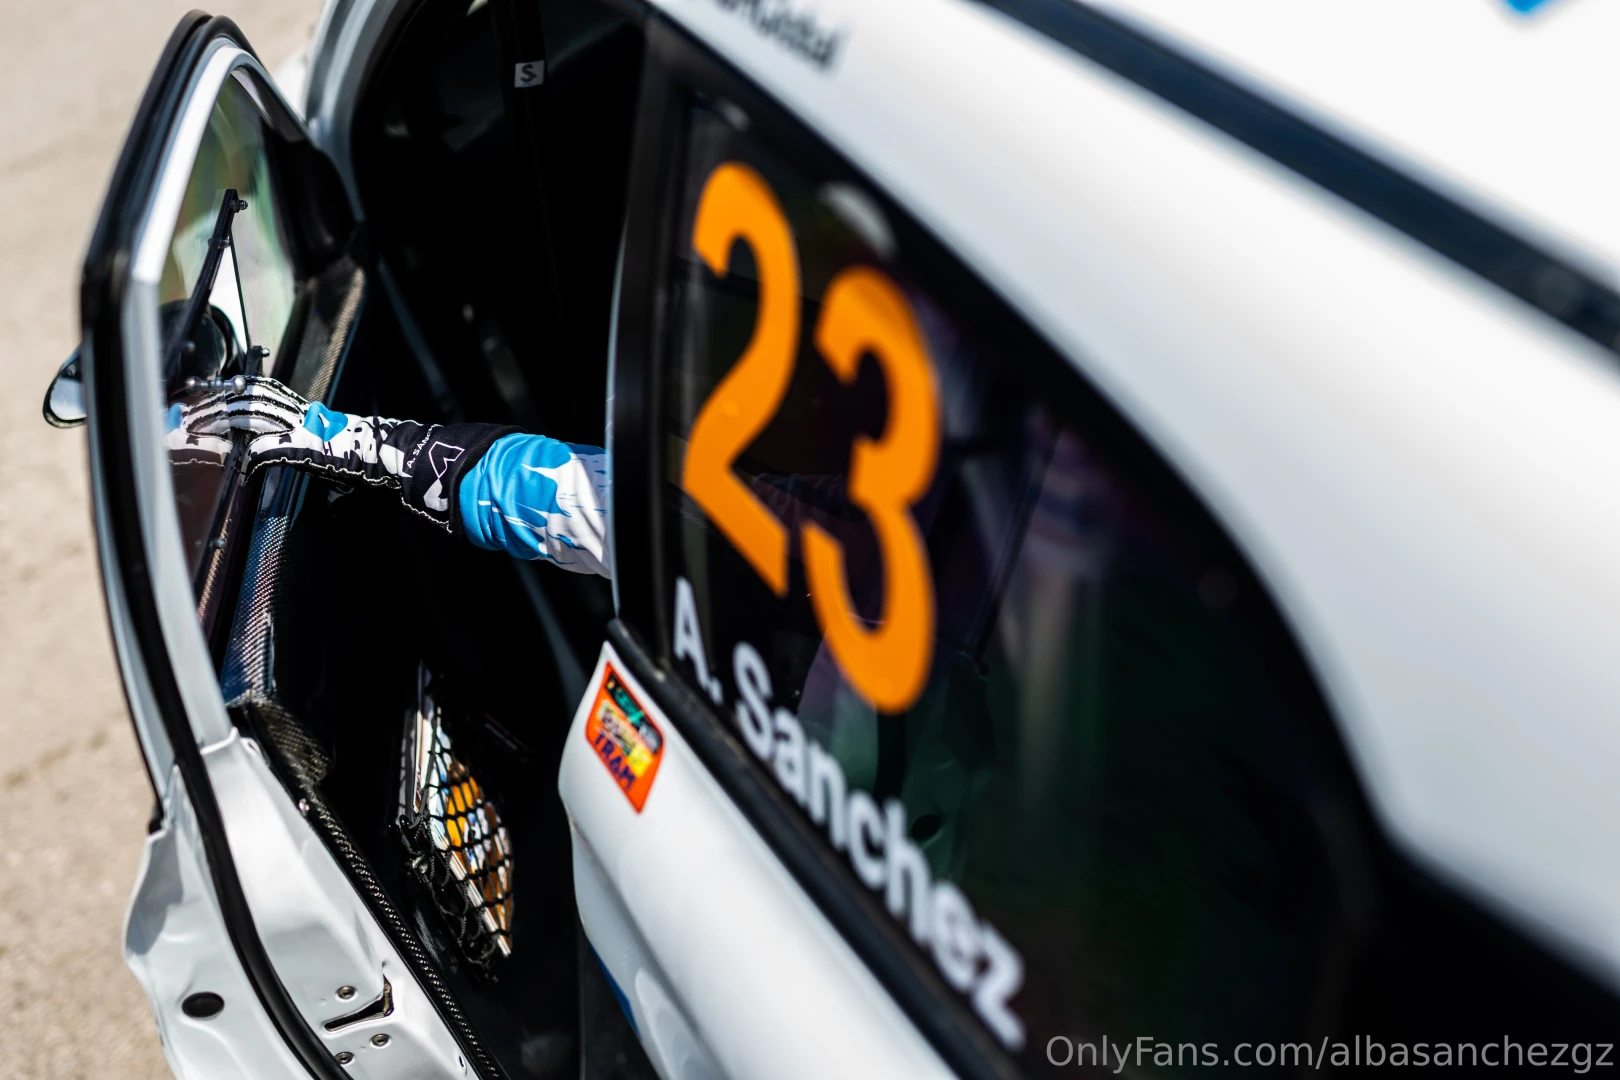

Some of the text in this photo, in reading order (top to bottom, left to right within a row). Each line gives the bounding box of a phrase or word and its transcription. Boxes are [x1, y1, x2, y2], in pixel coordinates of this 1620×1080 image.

[681, 162, 940, 712] 23
[593, 729, 637, 792] TRAM
[672, 576, 1026, 1050] A. Sanchez
